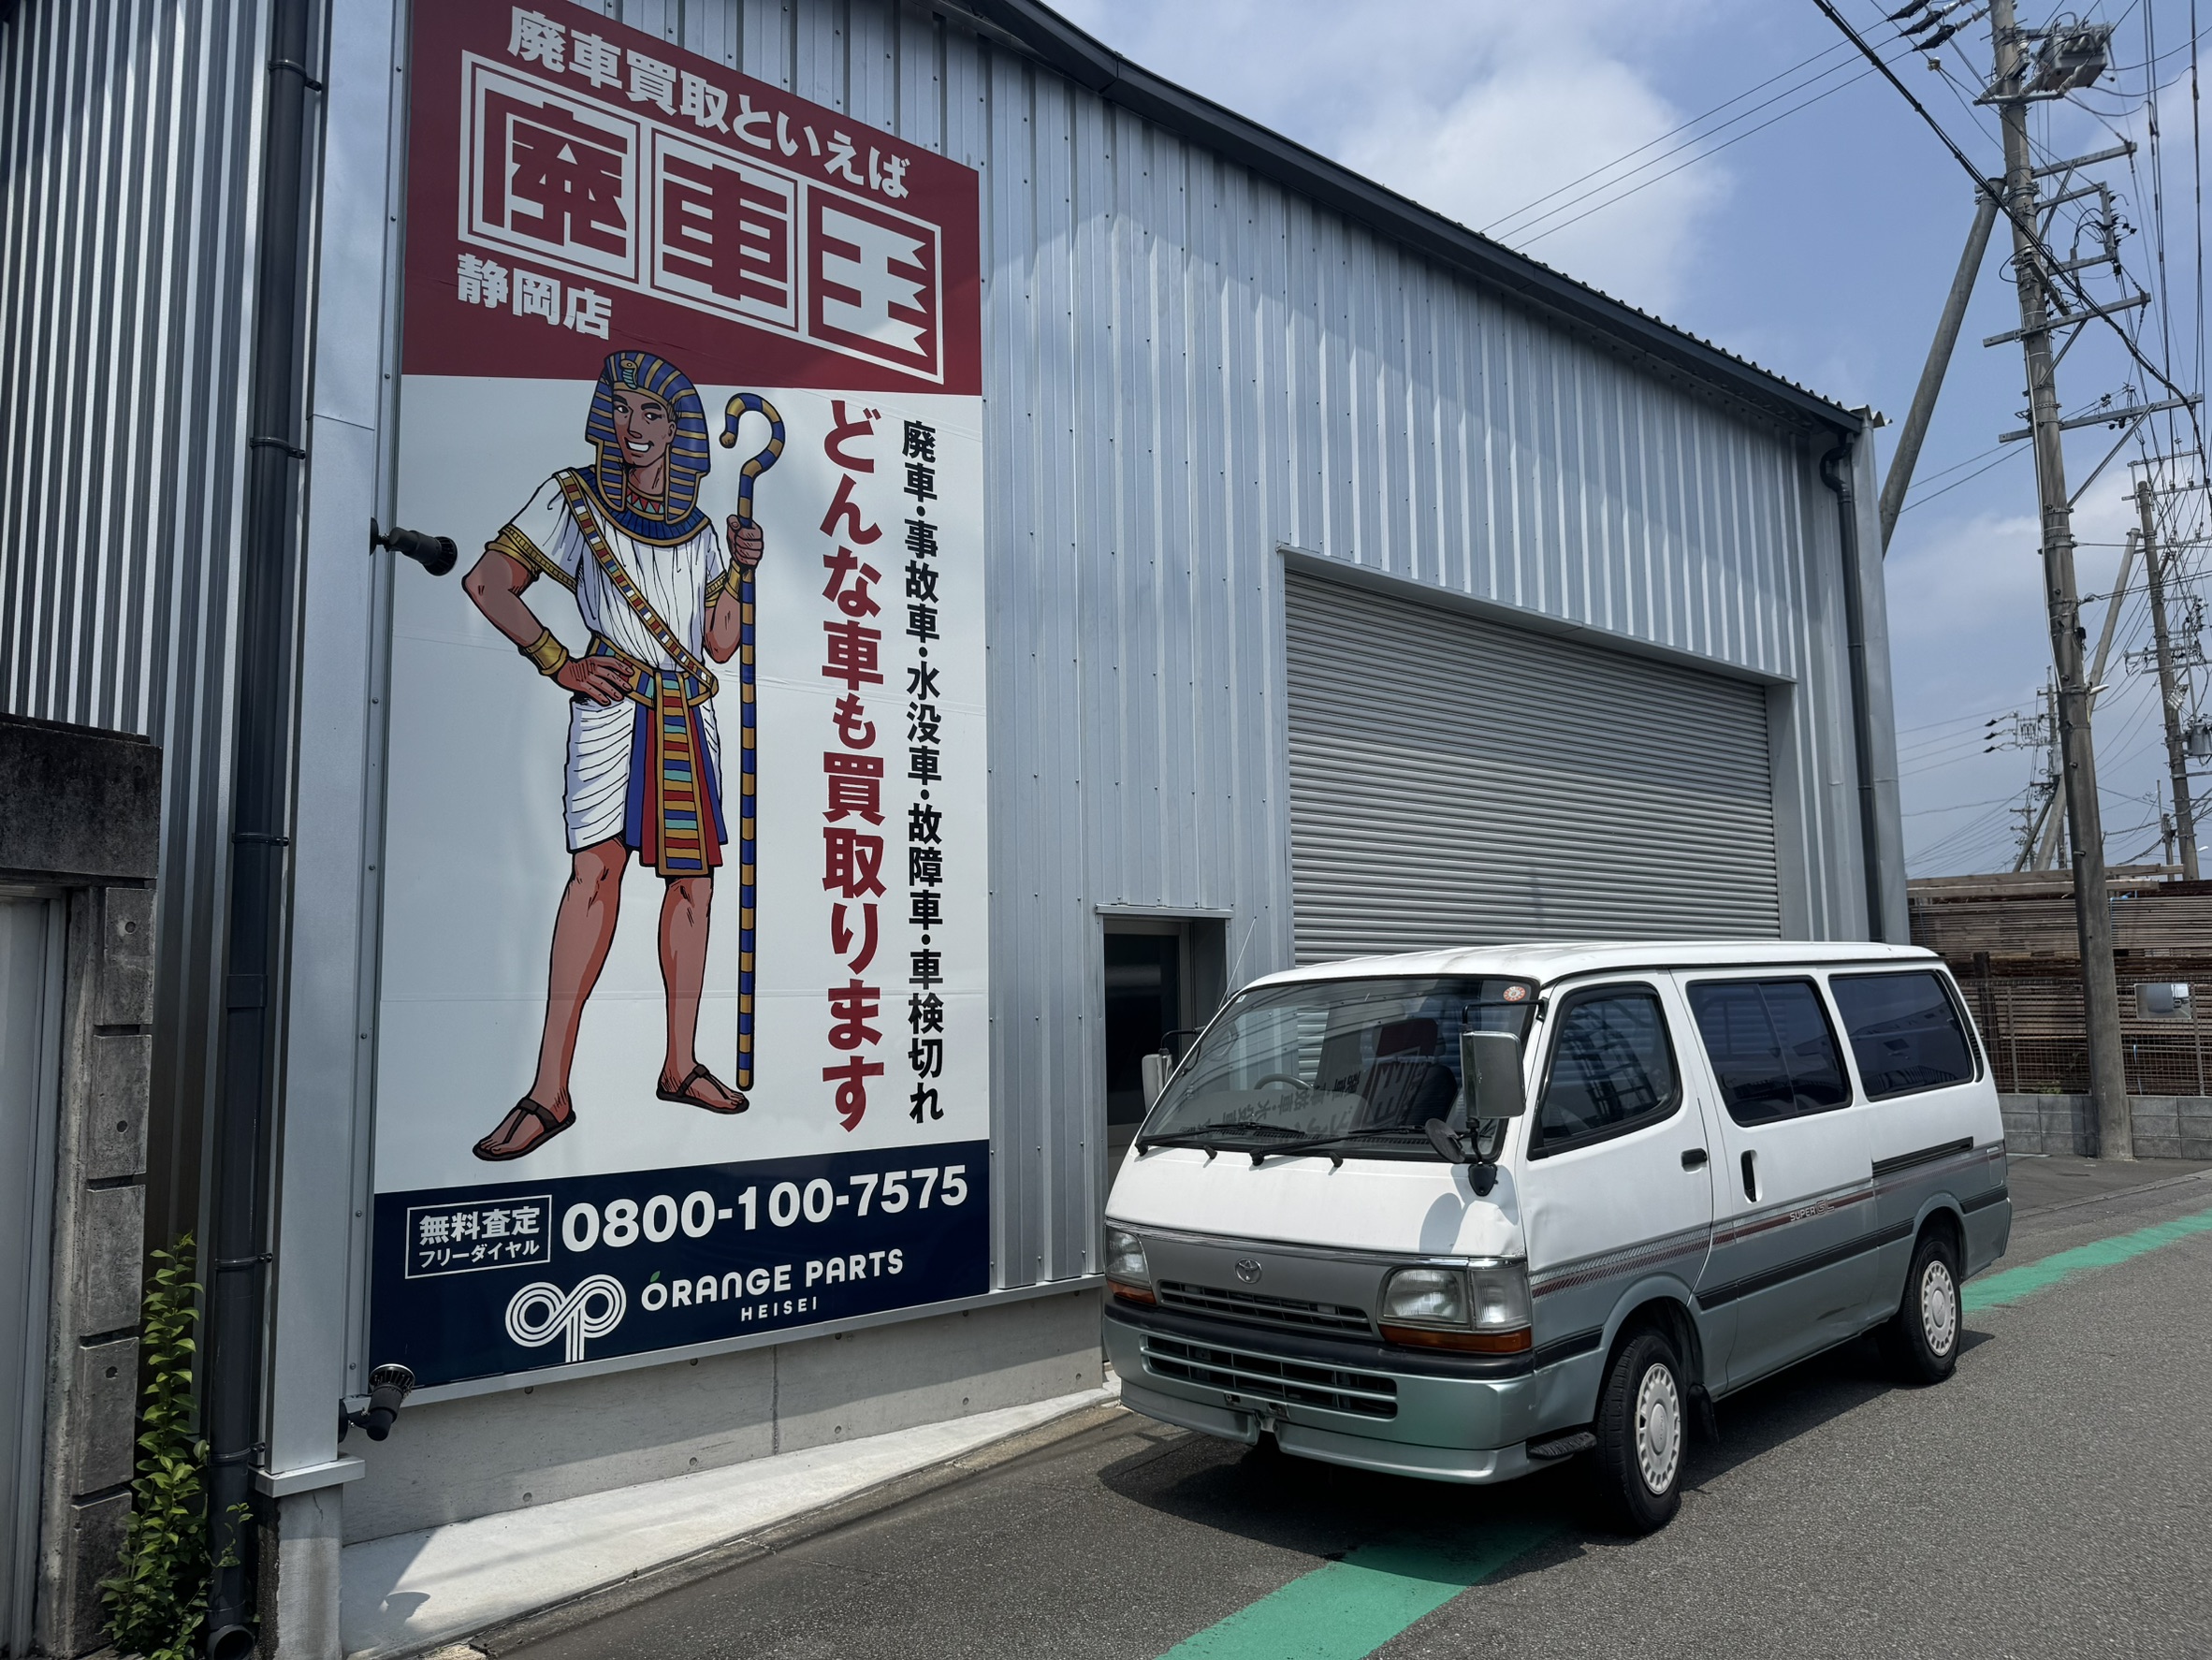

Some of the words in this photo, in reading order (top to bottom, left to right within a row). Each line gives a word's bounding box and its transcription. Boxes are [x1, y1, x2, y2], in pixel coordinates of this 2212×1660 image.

[506, 6, 910, 199] 廃車買取といえば
[458, 253, 612, 341] 静岡店
[819, 400, 887, 1132] どんな車も買取ります
[419, 1205, 541, 1245] 無料査定
[561, 1164, 968, 1253] 0800-100-7575
[1789, 1206, 1816, 1222] SUPER
[1816, 1199, 1835, 1216] GL
[418, 1240, 541, 1268] フリーダイヤル
[805, 1248, 904, 1287] PARTS
[740, 1296, 818, 1322] HEISEI
